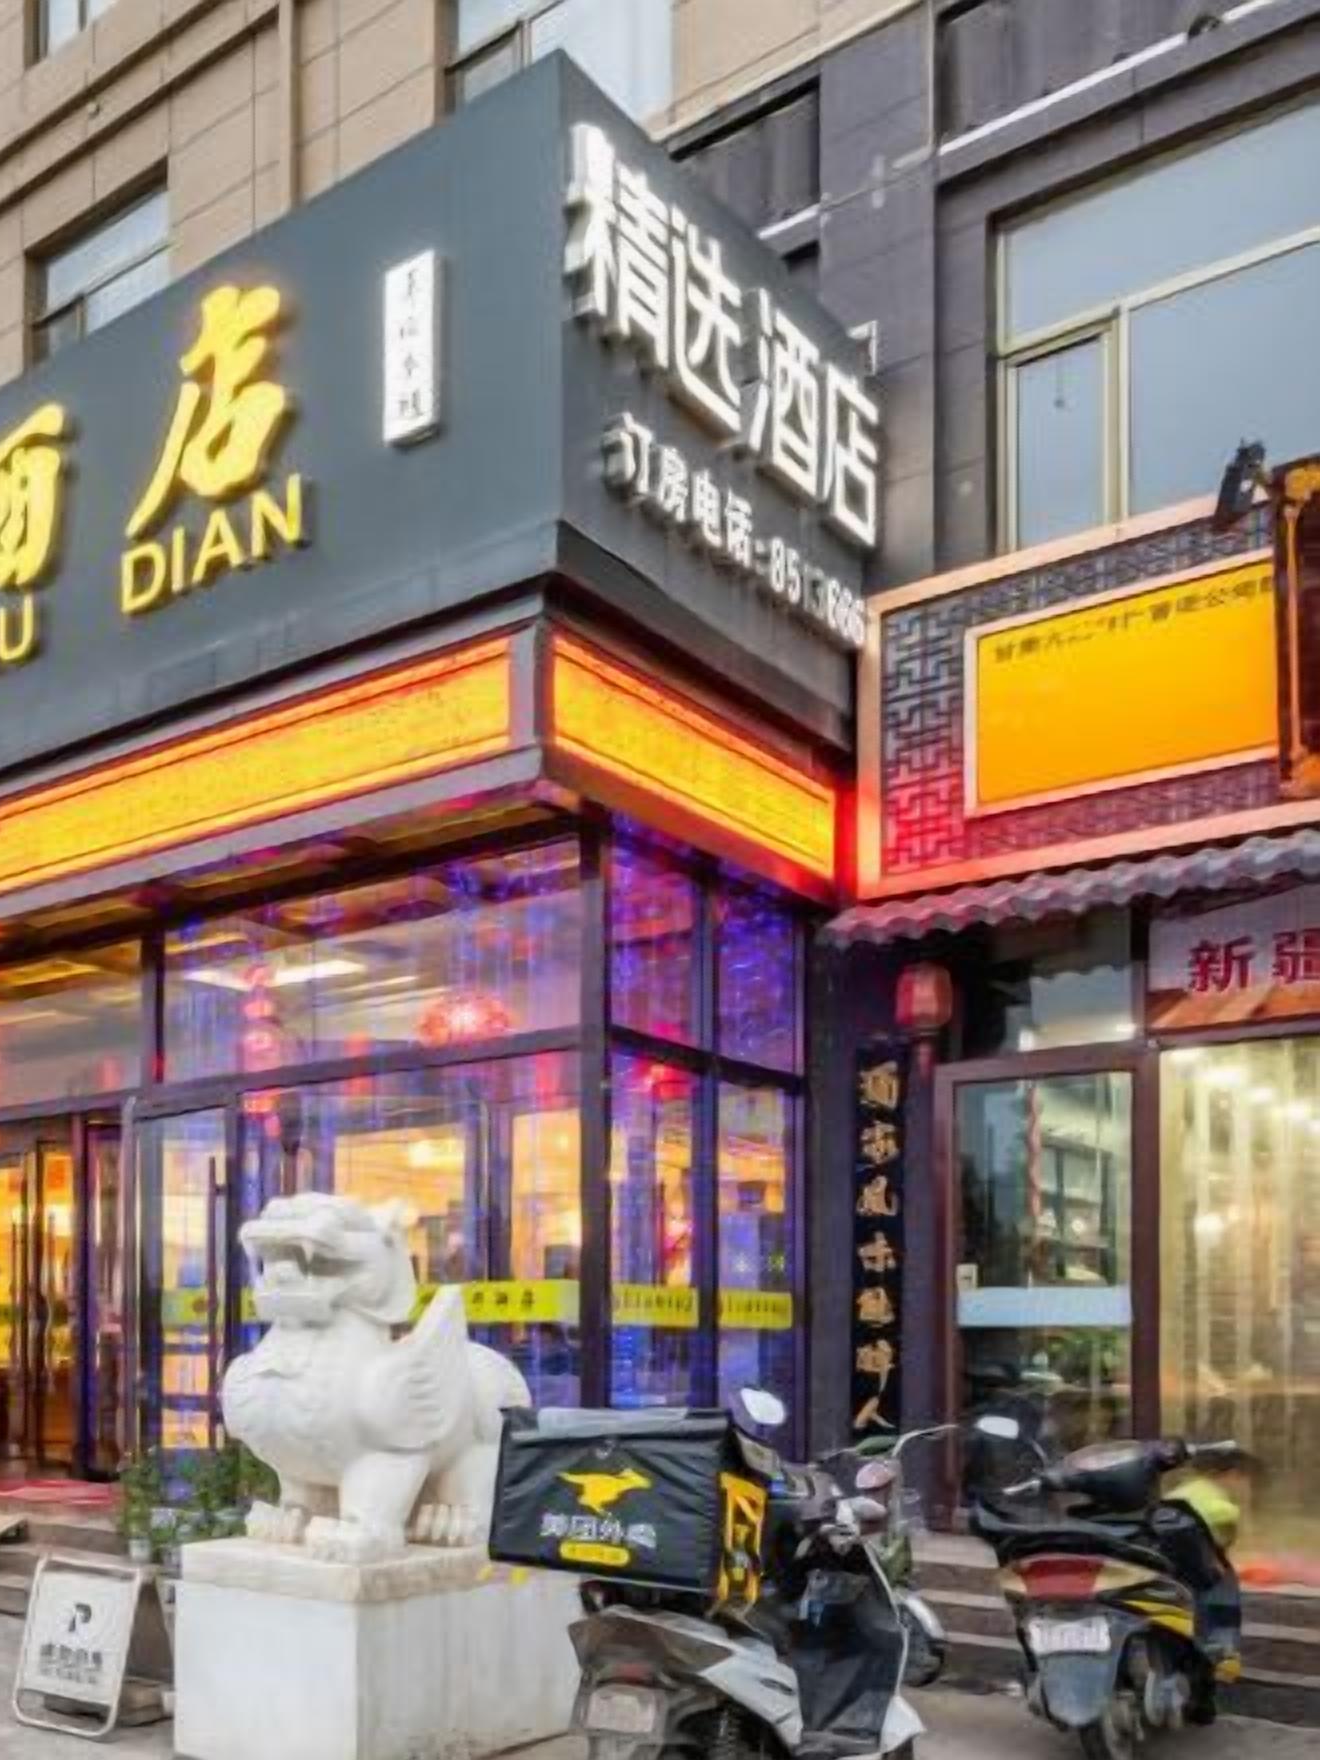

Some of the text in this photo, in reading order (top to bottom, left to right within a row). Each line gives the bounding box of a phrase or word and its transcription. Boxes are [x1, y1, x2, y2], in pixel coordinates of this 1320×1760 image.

[564, 122, 878, 548] 精选酒店
[120, 472, 305, 614] DIAN
